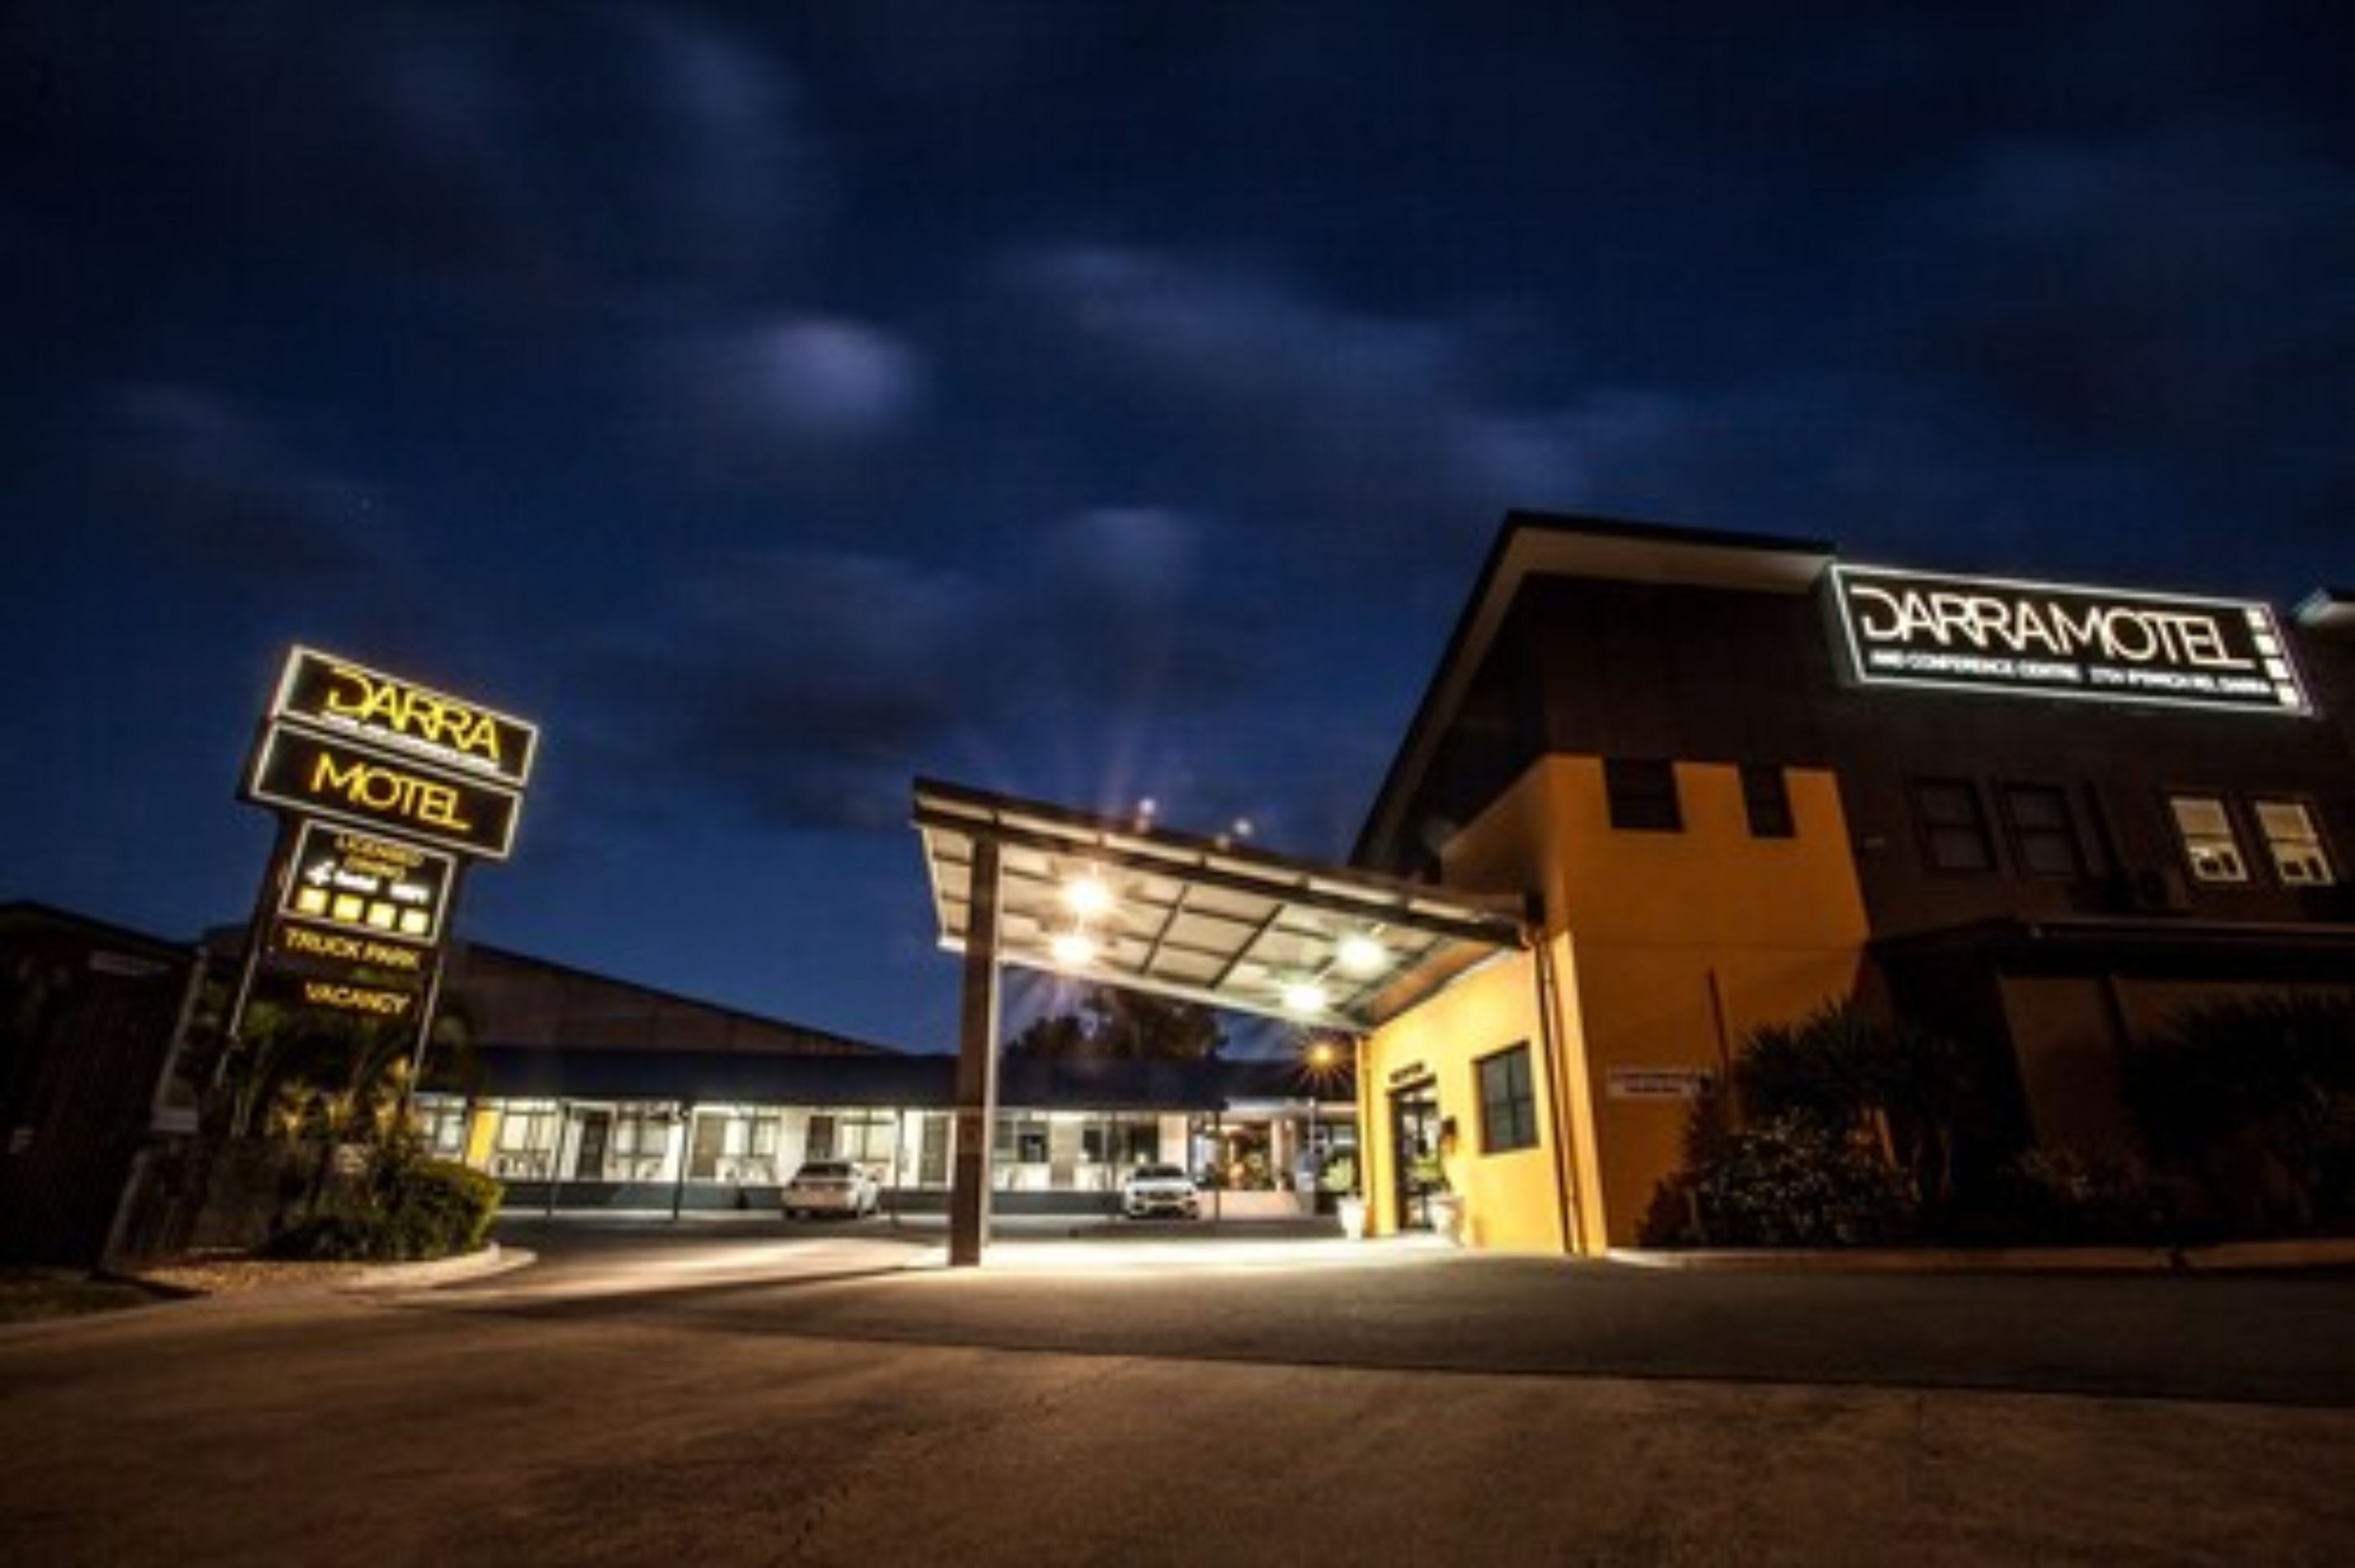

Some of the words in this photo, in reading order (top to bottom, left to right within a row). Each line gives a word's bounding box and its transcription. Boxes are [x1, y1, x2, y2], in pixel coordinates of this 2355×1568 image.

[326, 664, 501, 760] DARRA
[309, 752, 471, 831] MOTEL
[285, 926, 362, 961] TRUCK
[304, 982, 411, 1015] VACANCY
